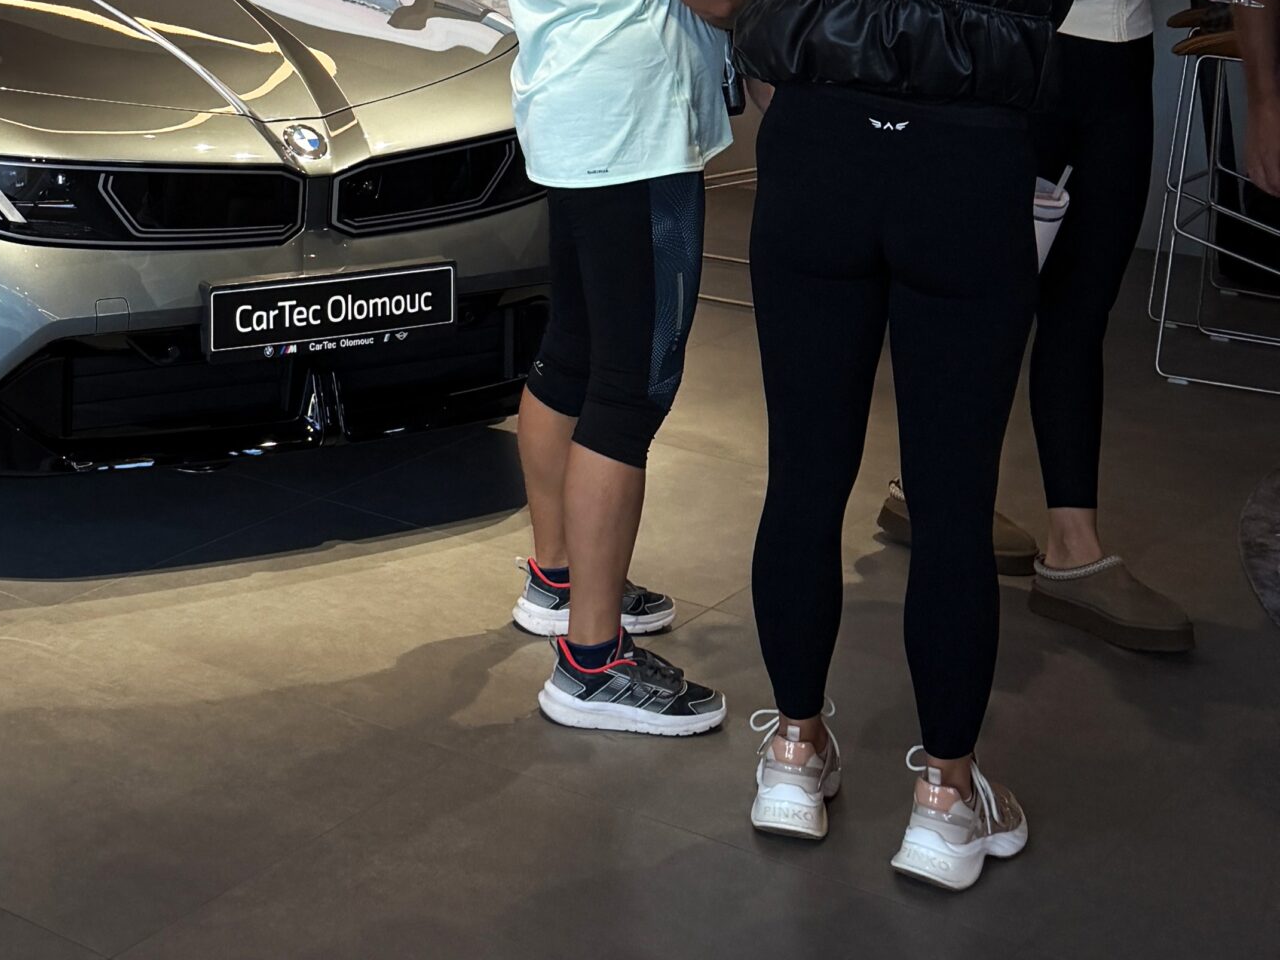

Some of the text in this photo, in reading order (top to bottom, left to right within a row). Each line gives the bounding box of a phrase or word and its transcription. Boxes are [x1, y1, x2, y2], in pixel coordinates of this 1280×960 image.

[235, 291, 433, 333] CarTec Olomouc
[308, 340, 337, 352] CarTec
[339, 337, 375, 348] Olomouc
[763, 806, 815, 822] PINKO
